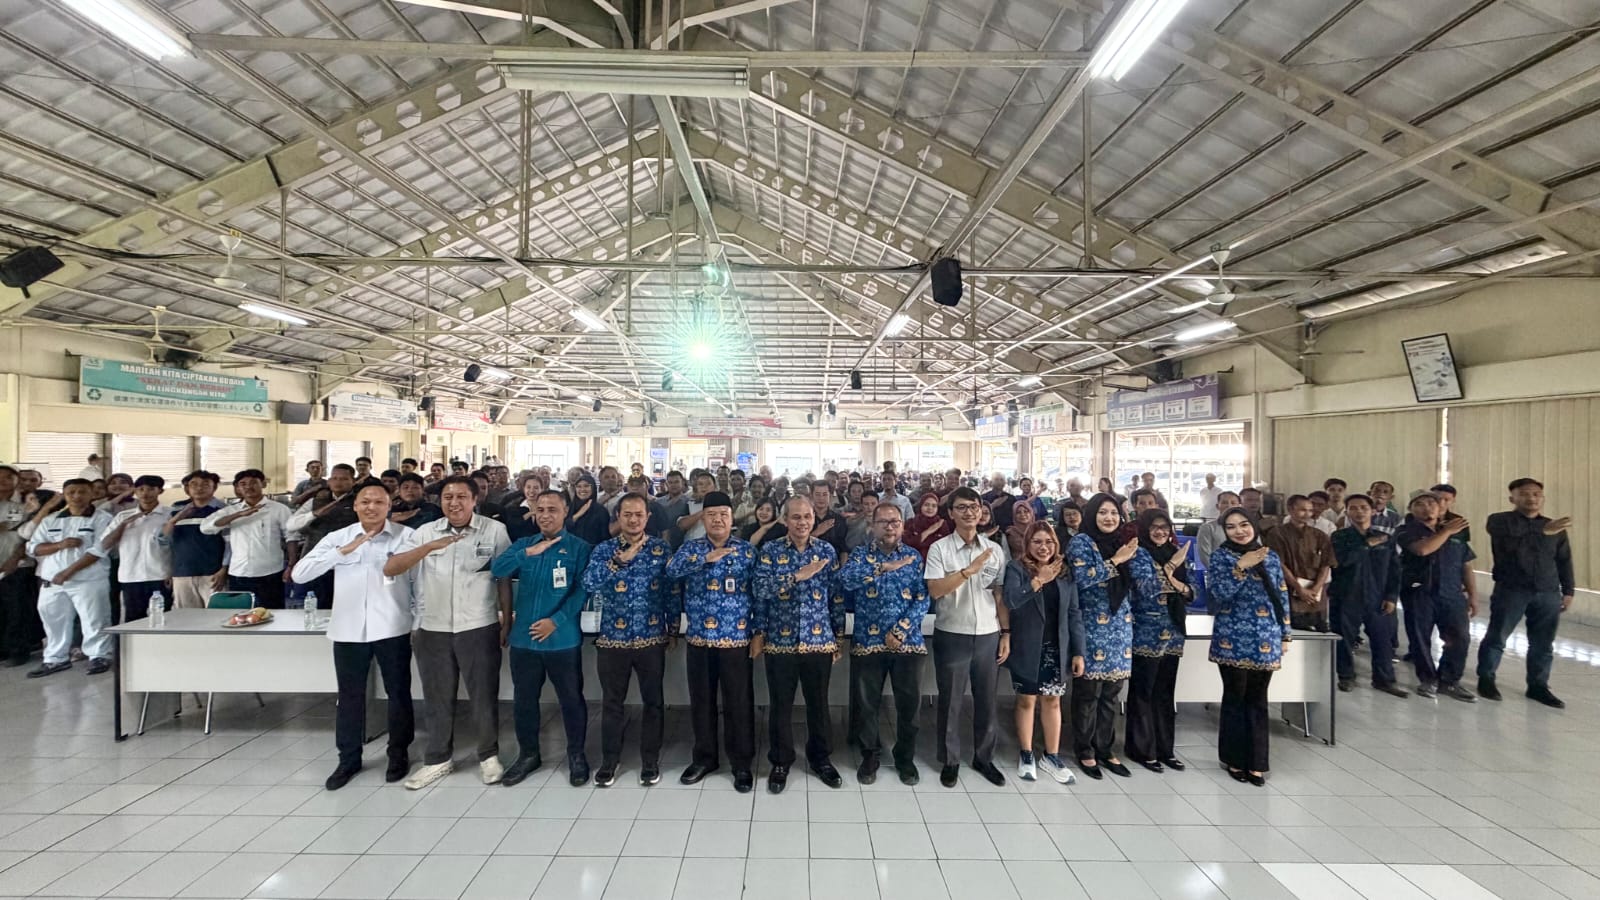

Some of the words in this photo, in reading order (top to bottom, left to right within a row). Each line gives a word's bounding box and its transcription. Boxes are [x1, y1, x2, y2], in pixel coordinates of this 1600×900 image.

[121, 364, 160, 376] MARILAH
[162, 369, 181, 378] KITA
[181, 372, 218, 383] CIPTAKAN
[146, 384, 156, 392] DI
[157, 386, 208, 396] LINGKUNGAN
